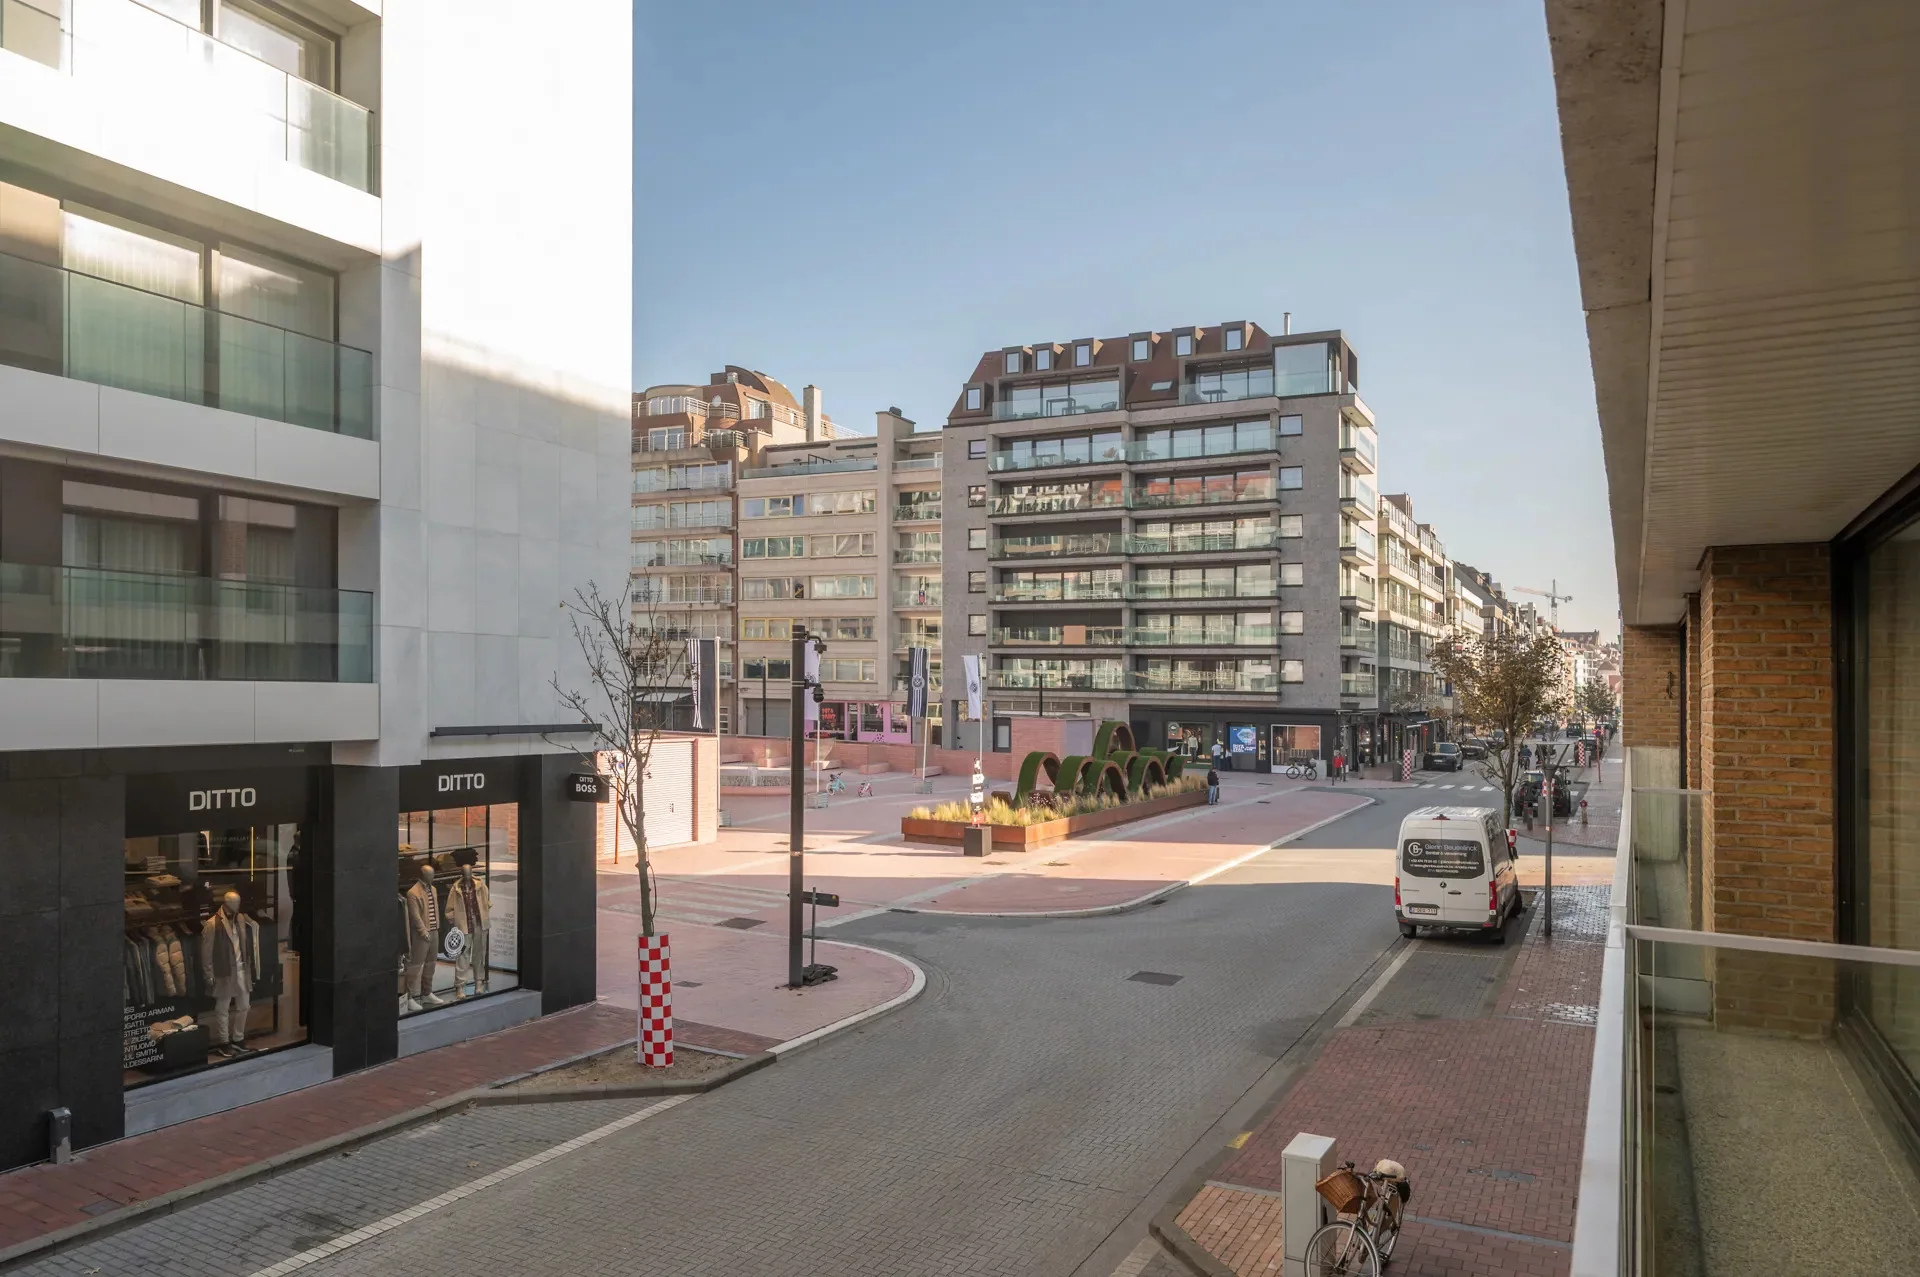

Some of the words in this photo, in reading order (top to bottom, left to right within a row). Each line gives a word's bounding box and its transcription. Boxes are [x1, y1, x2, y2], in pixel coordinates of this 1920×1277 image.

[438, 772, 485, 792] DITTO
[576, 784, 596, 793] BOSS
[189, 787, 257, 811] DITTO
[148, 1006, 174, 1016] ARMANI
[135, 1048, 158, 1059] SMITH
